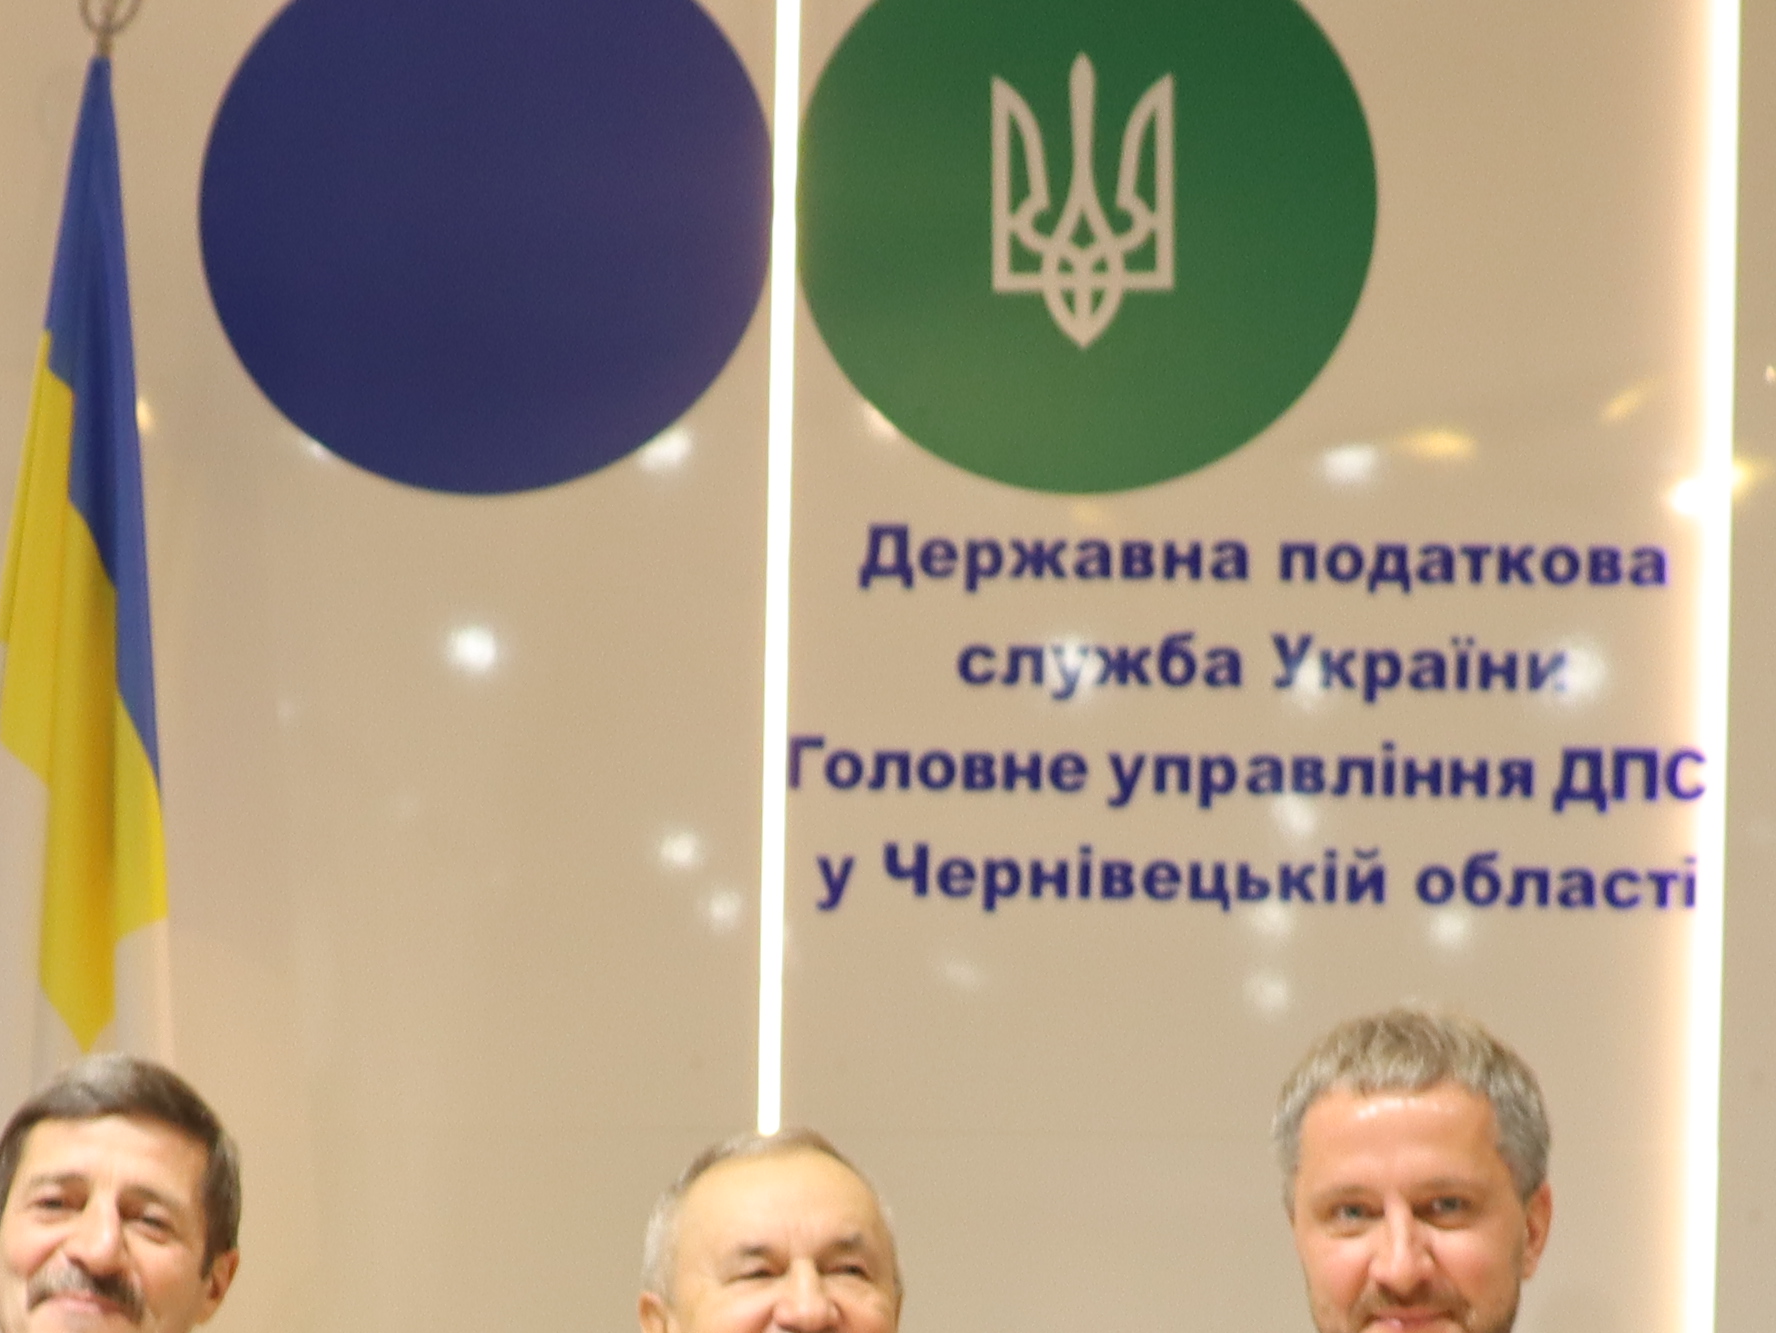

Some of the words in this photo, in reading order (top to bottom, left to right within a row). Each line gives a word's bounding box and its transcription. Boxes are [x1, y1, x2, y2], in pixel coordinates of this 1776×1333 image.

[858, 522, 1250, 592] Державна
[1278, 538, 1668, 594] податкова
[956, 633, 1244, 700] служба
[1270, 632, 1574, 704] України
[787, 734, 1089, 795] Головне
[1108, 743, 1536, 808] управління
[1552, 746, 1709, 813] ДПС
[816, 853, 855, 912] у
[882, 843, 1388, 914] Чернівецькій
[1414, 850, 1700, 914] області
